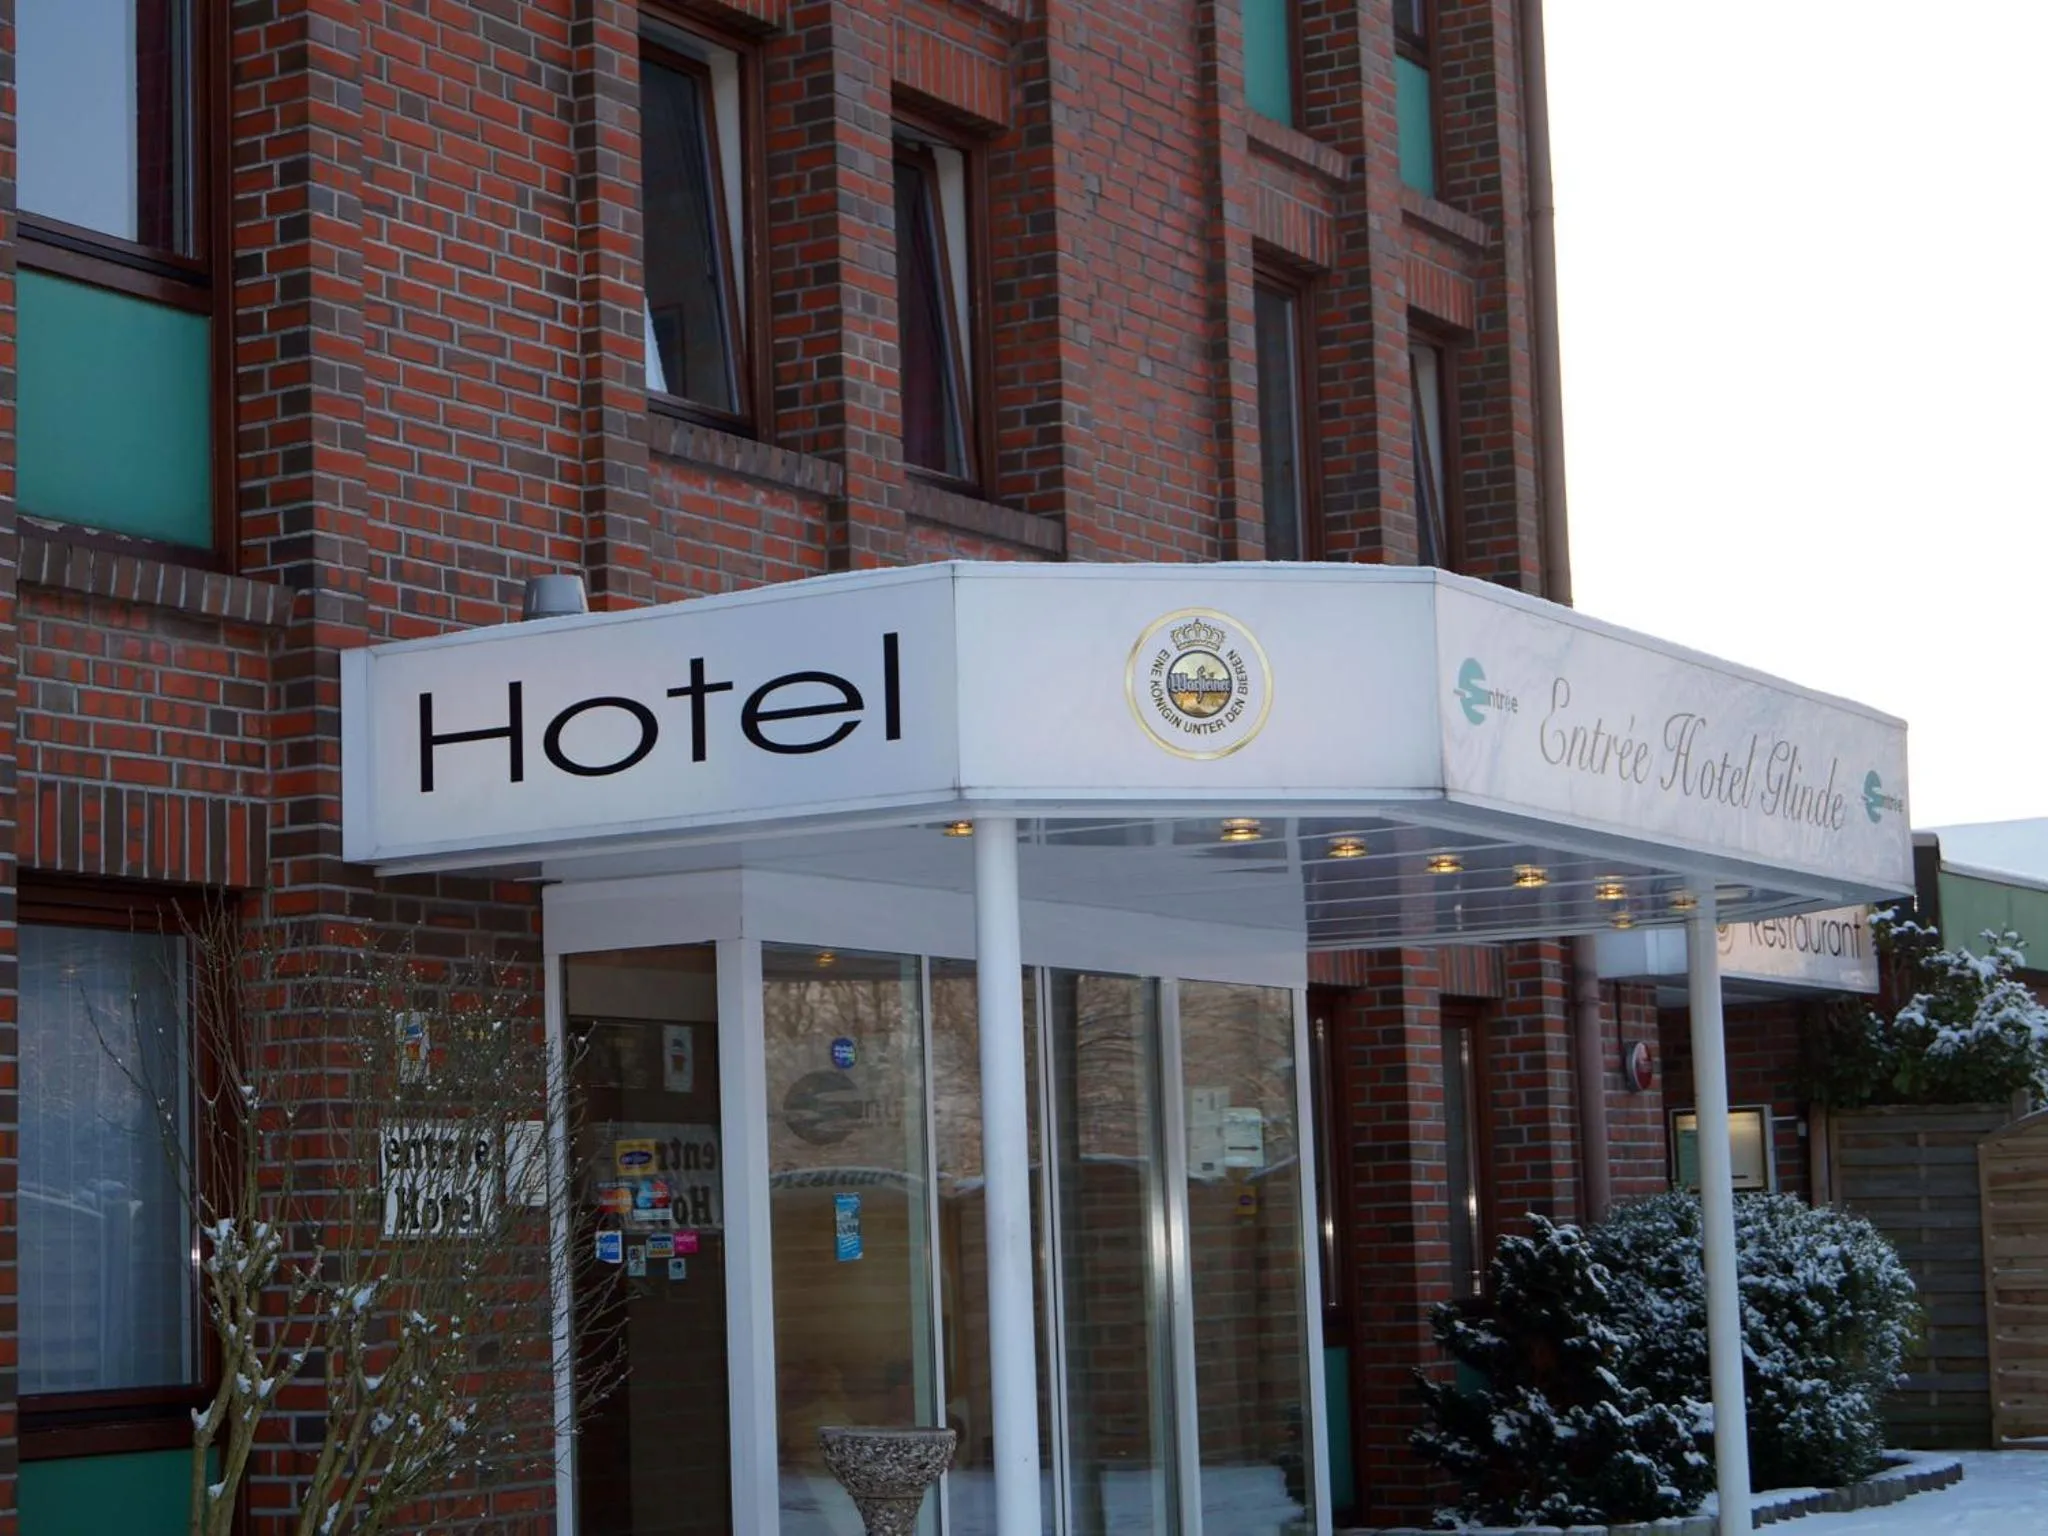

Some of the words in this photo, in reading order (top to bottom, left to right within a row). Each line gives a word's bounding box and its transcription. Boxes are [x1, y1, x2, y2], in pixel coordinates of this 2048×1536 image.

[1151, 648, 1171, 676] EINE
[1226, 649, 1248, 696] BIEREN
[419, 631, 901, 793] Hotel
[1150, 680, 1182, 728] KÖNIGIN
[1184, 719, 1226, 735] UNTER
[1226, 699, 1246, 723] DEN
[1540, 677, 1648, 784] Entrée
[1660, 713, 1757, 809] Hotel
[1761, 740, 1846, 830] Glinde
[1749, 911, 1861, 959] Restaurant
